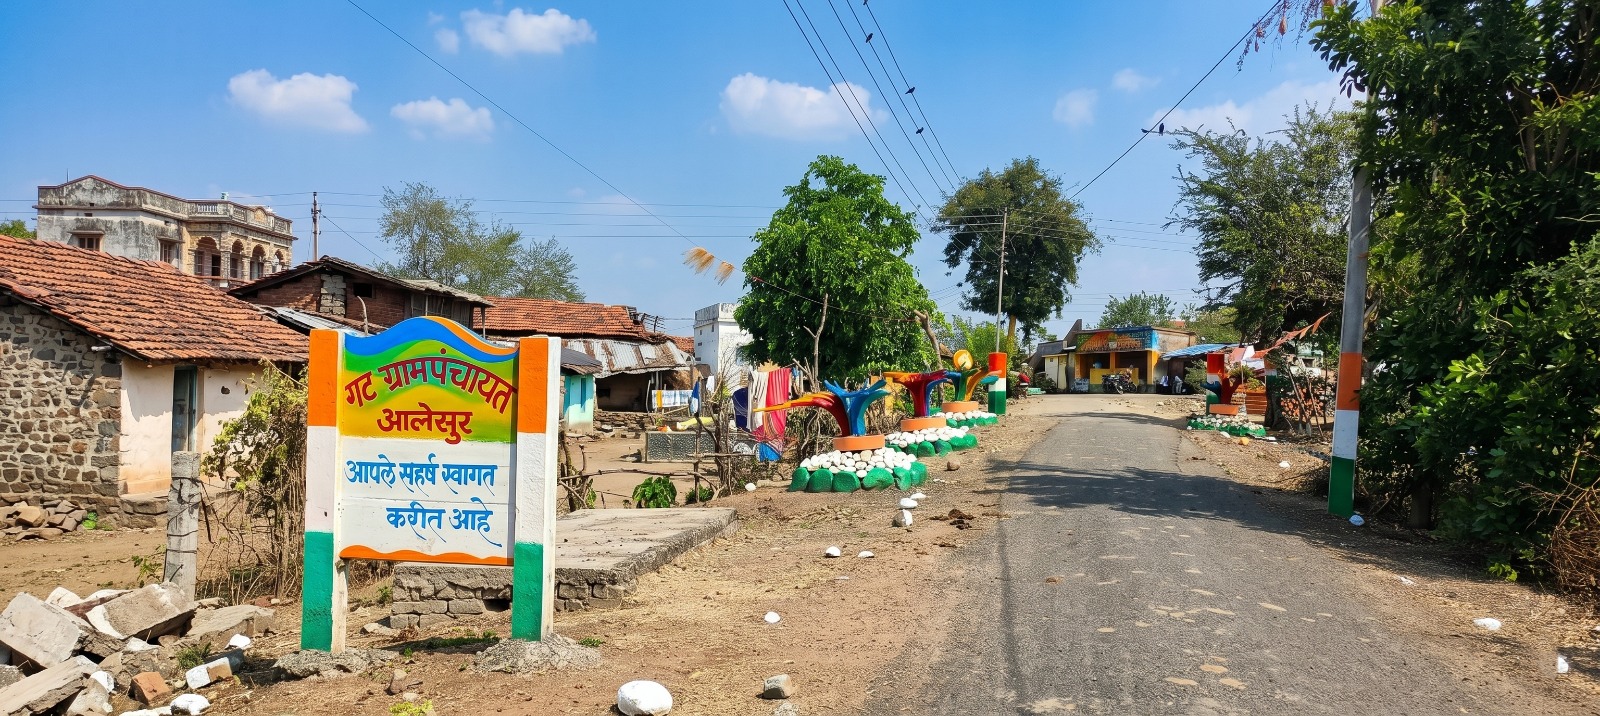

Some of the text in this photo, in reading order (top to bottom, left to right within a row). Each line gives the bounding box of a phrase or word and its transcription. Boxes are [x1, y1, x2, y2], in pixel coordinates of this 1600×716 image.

[345, 347, 517, 414] गट ग्रामपंचायत
[377, 402, 473, 445] आलेसुर
[344, 452, 498, 497] आपले सहर्ष स्वागत
[386, 497, 502, 548] करीत आहे
